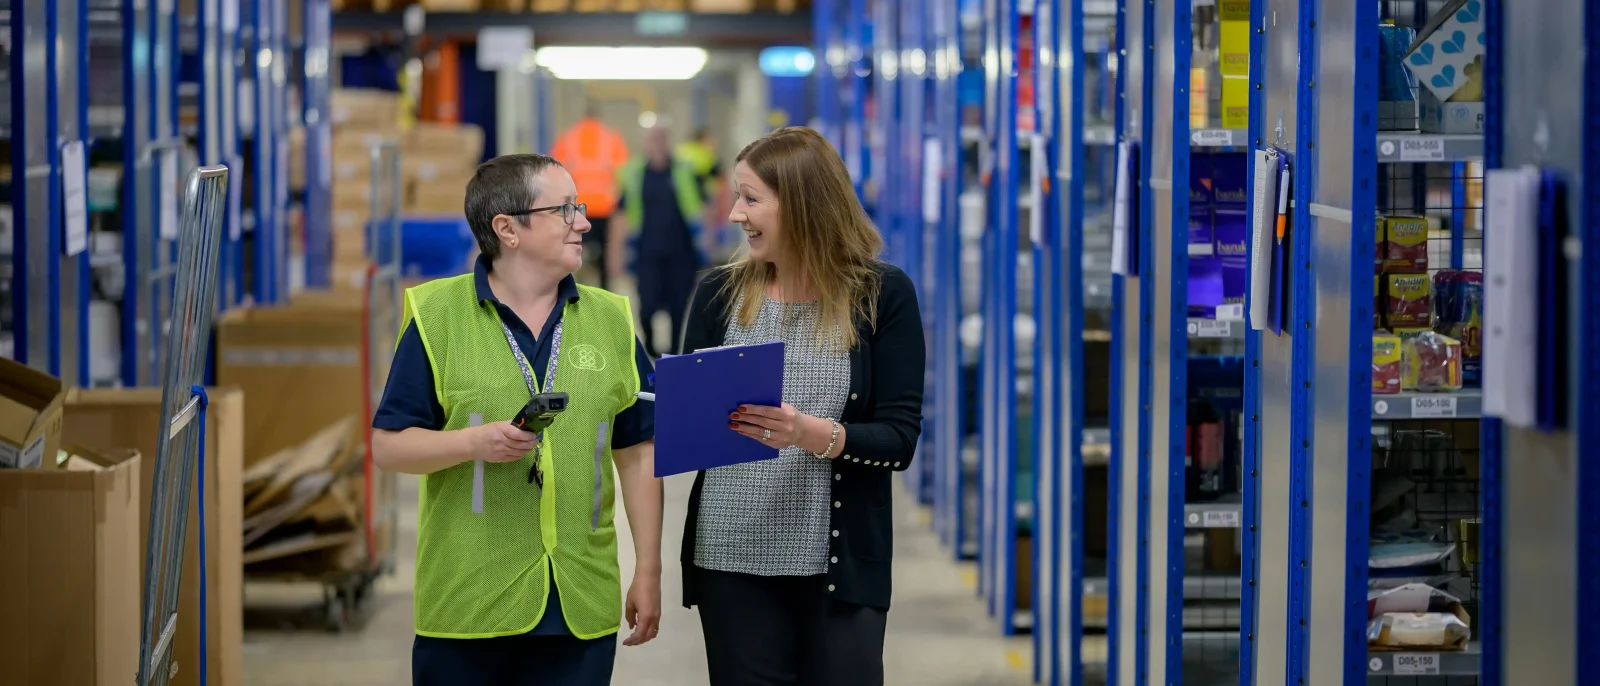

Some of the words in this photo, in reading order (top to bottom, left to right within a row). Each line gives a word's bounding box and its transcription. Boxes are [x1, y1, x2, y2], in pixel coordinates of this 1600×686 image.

[1404, 140, 1439, 150] D05-050
[1394, 276, 1425, 285] Anadin
[1416, 399, 1451, 408] D05-100
[1399, 656, 1433, 665] D05-150
